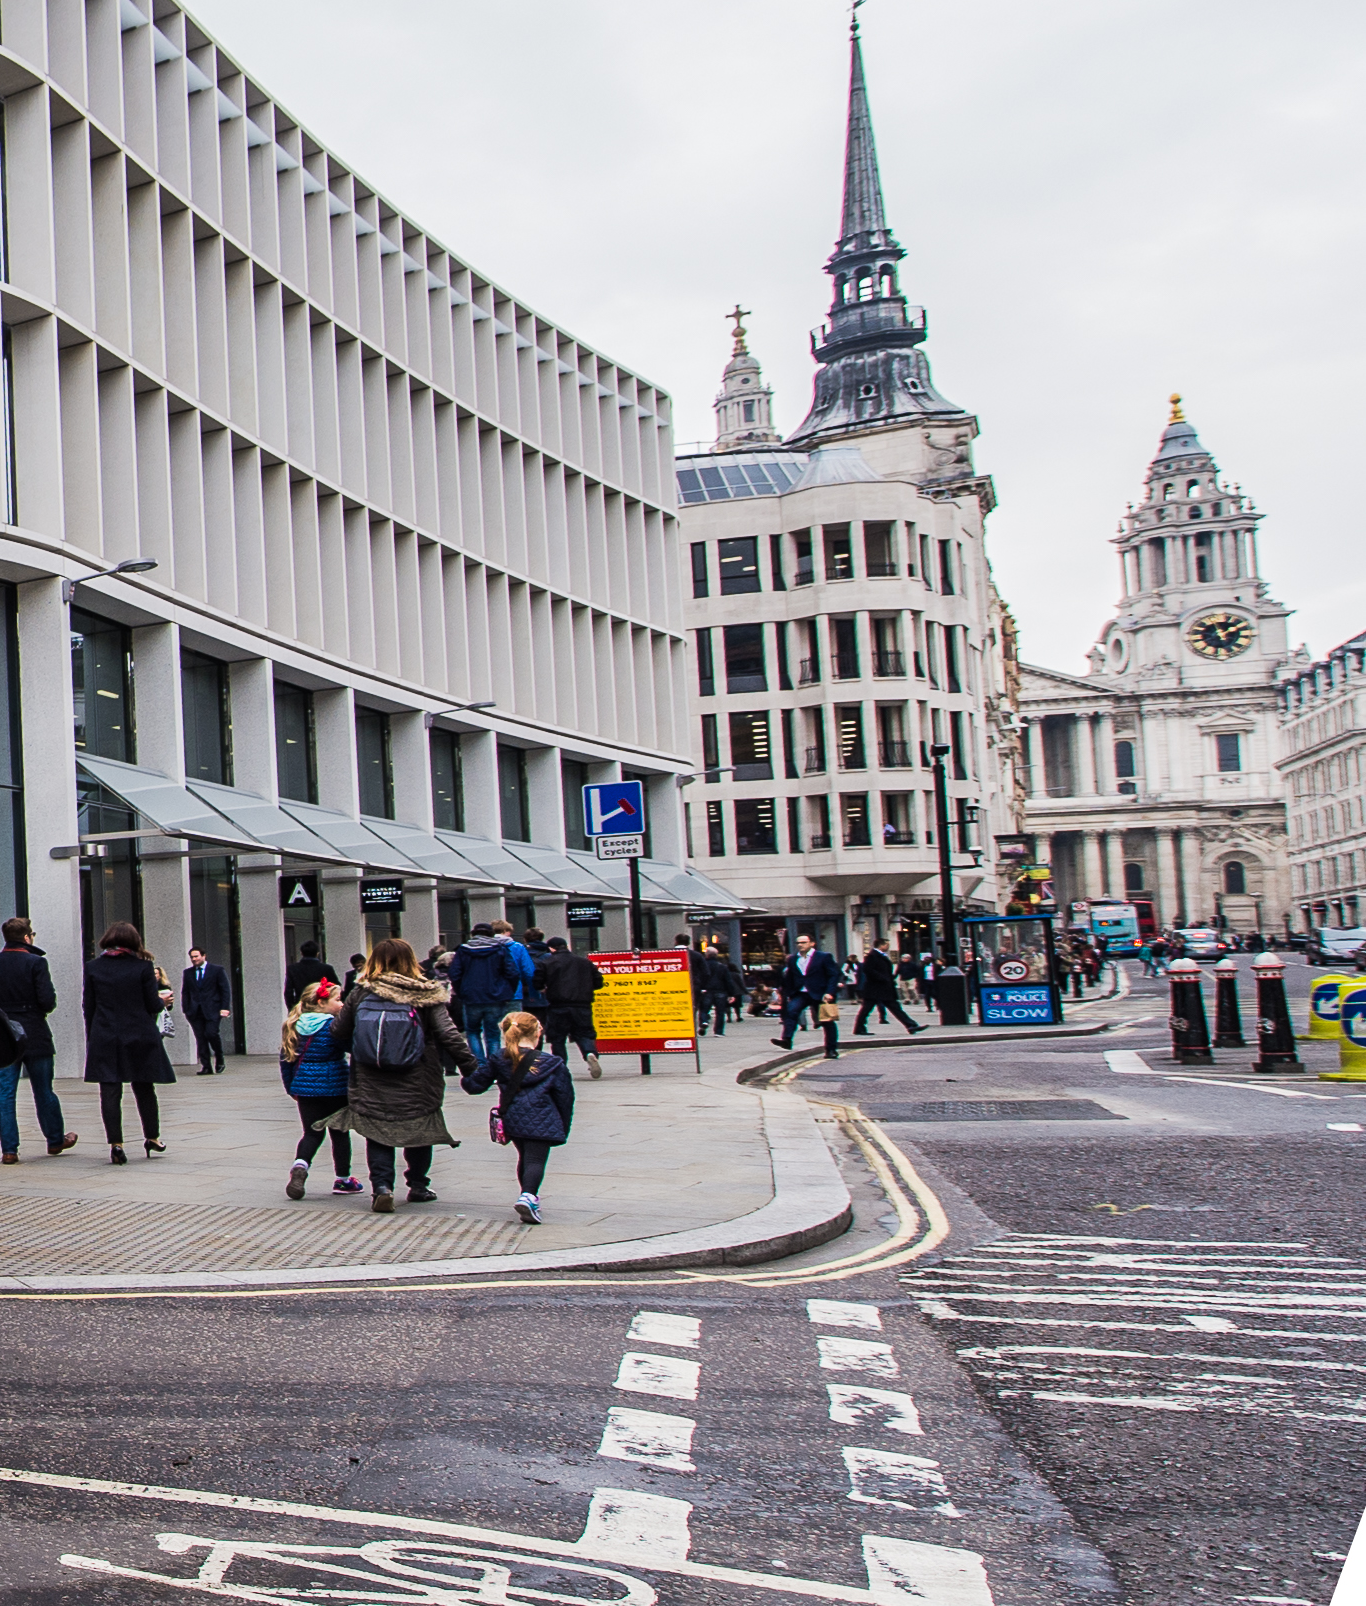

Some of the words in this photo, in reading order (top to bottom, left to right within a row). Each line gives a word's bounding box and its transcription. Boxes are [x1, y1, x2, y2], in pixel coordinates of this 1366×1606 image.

[602, 838, 639, 847] Except
[604, 847, 638, 856] cycles
[288, 882, 311, 904] A
[1003, 966, 1024, 975] 20
[1007, 994, 1047, 1002] POLICE
[987, 1008, 1048, 1018] SLOW
